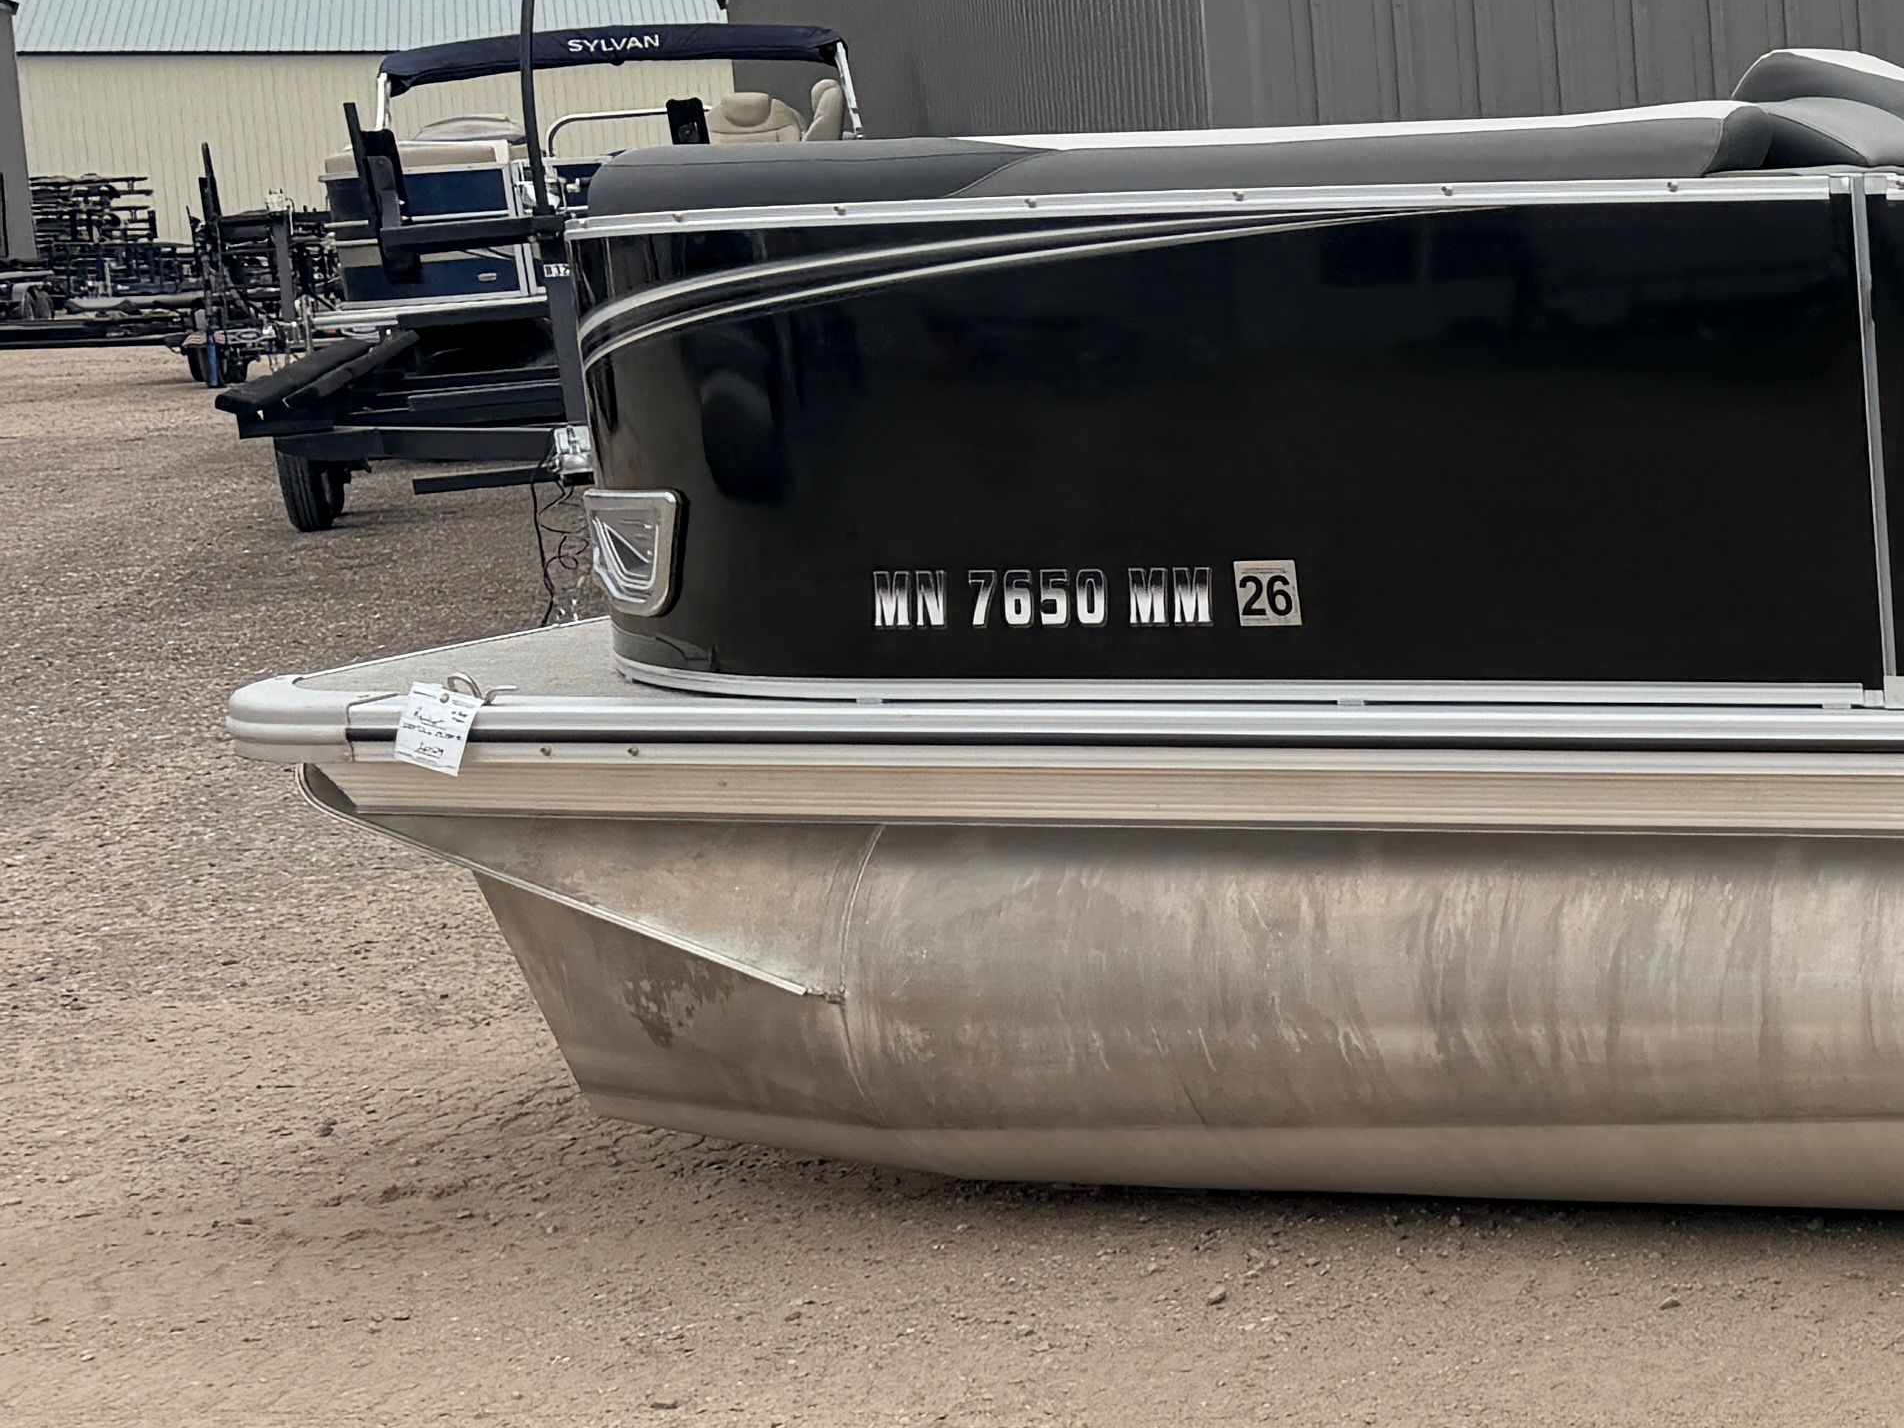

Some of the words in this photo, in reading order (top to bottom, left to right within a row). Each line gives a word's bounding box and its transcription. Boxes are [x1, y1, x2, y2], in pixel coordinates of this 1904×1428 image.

[567, 34, 660, 52] SYLVAN
[873, 570, 953, 629] MN
[968, 568, 1109, 628] 7650
[1128, 567, 1213, 627] MM
[1239, 575, 1293, 617] 26
